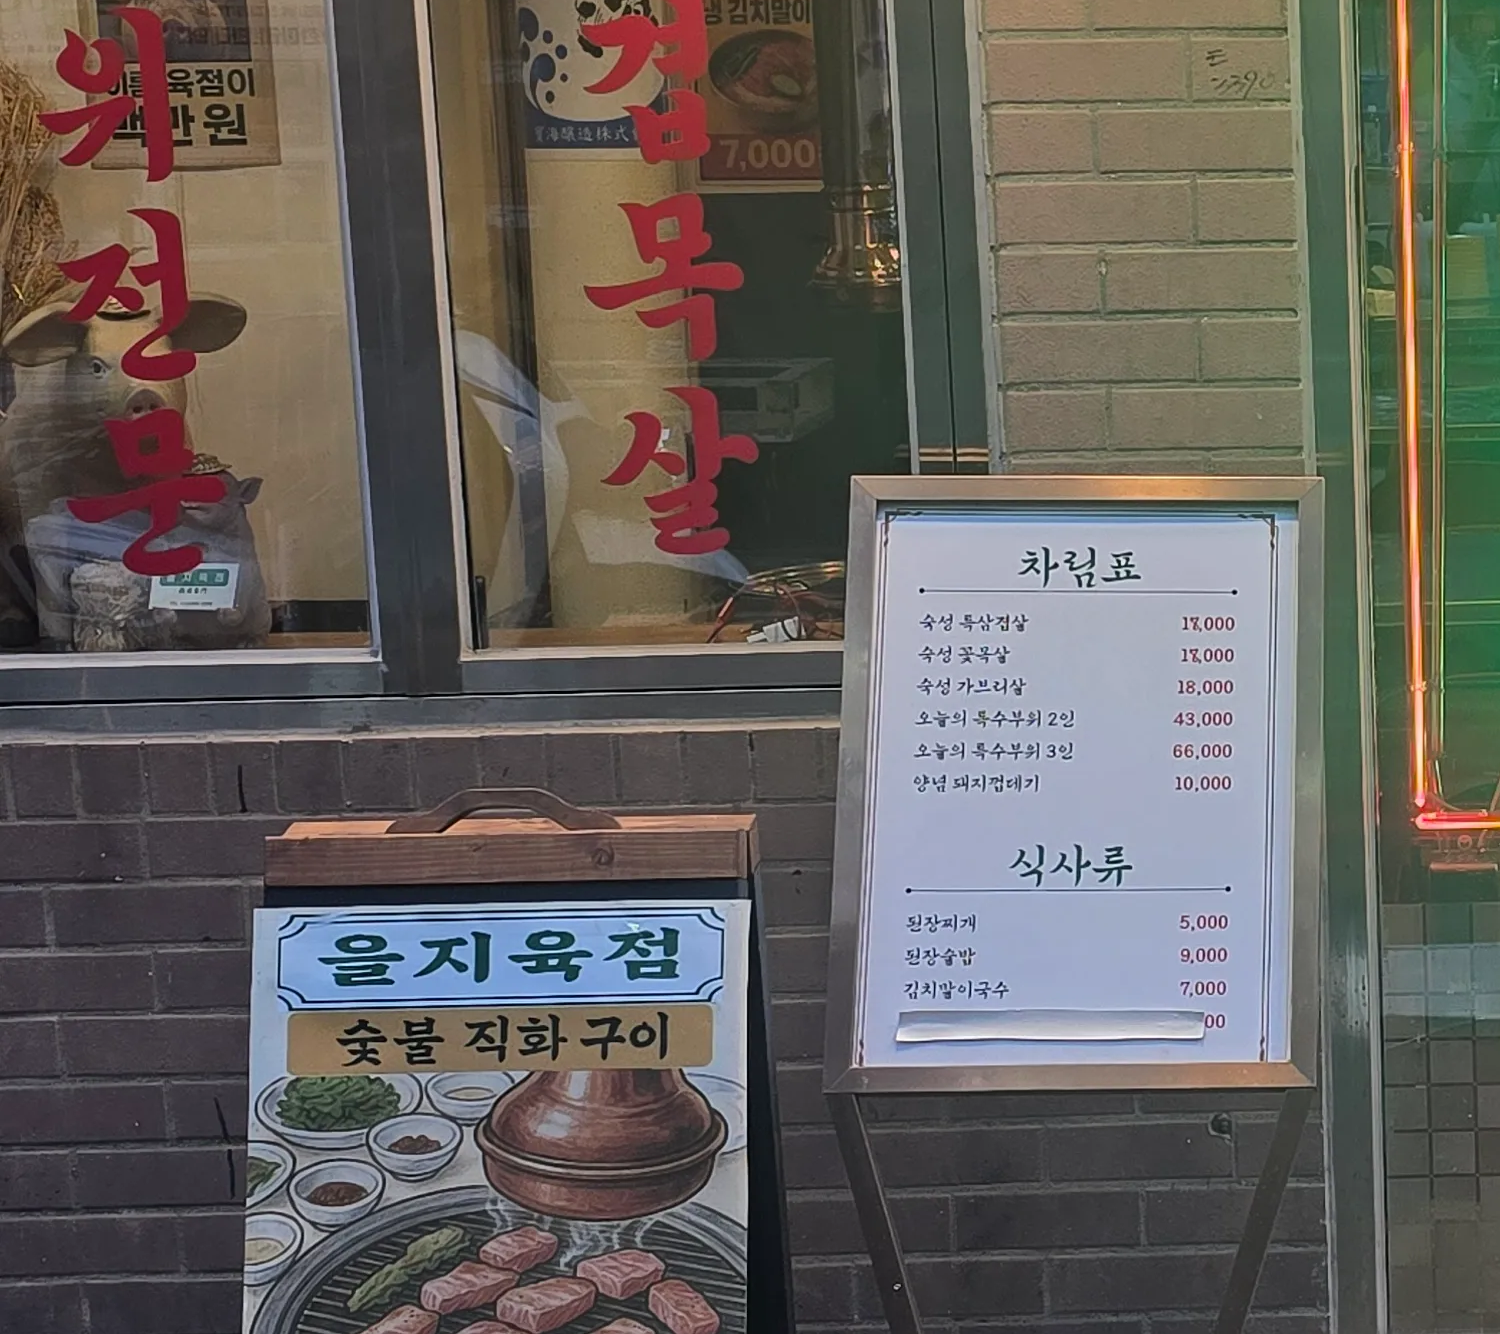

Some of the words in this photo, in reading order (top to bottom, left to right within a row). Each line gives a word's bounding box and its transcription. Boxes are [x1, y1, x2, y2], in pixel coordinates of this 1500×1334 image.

[203, 103, 248, 146] 원
[720, 139, 816, 172] 7,000
[1017, 546, 1142, 588] 차림표
[919, 613, 954, 632] 숙성
[918, 645, 952, 664] 숙성
[957, 645, 1011, 664] 꽃목살
[916, 677, 951, 696] 숙성
[956, 677, 1027, 696] 가브리살
[1177, 680, 1234, 696] 18,000
[915, 709, 967, 728] 오늘의
[972, 709, 1042, 728] 특수부위
[1048, 710, 1075, 728] 2인
[1173, 712, 1233, 727] 43,000
[913, 741, 966, 761] 오늘의
[971, 742, 1041, 760] 특수부위
[1046, 742, 1074, 760] 3인
[1173, 744, 1232, 760] 66,000
[913, 773, 947, 793] 양념
[952, 773, 1040, 793] 돼지껍데기
[1175, 776, 1231, 792] 10,000
[1008, 844, 1134, 888] 식사류
[906, 913, 977, 933] 된장찌개
[1180, 915, 1228, 931] 5,000
[317, 926, 681, 987] 을지육점
[1180, 948, 1227, 964] 9,000
[903, 980, 1010, 1000] 김치말이국수
[1180, 981, 1226, 998] 7,000
[336, 1016, 445, 1067] 숯불
[464, 1013, 569, 1062] 직화
[580, 1011, 669, 1060] 구이
